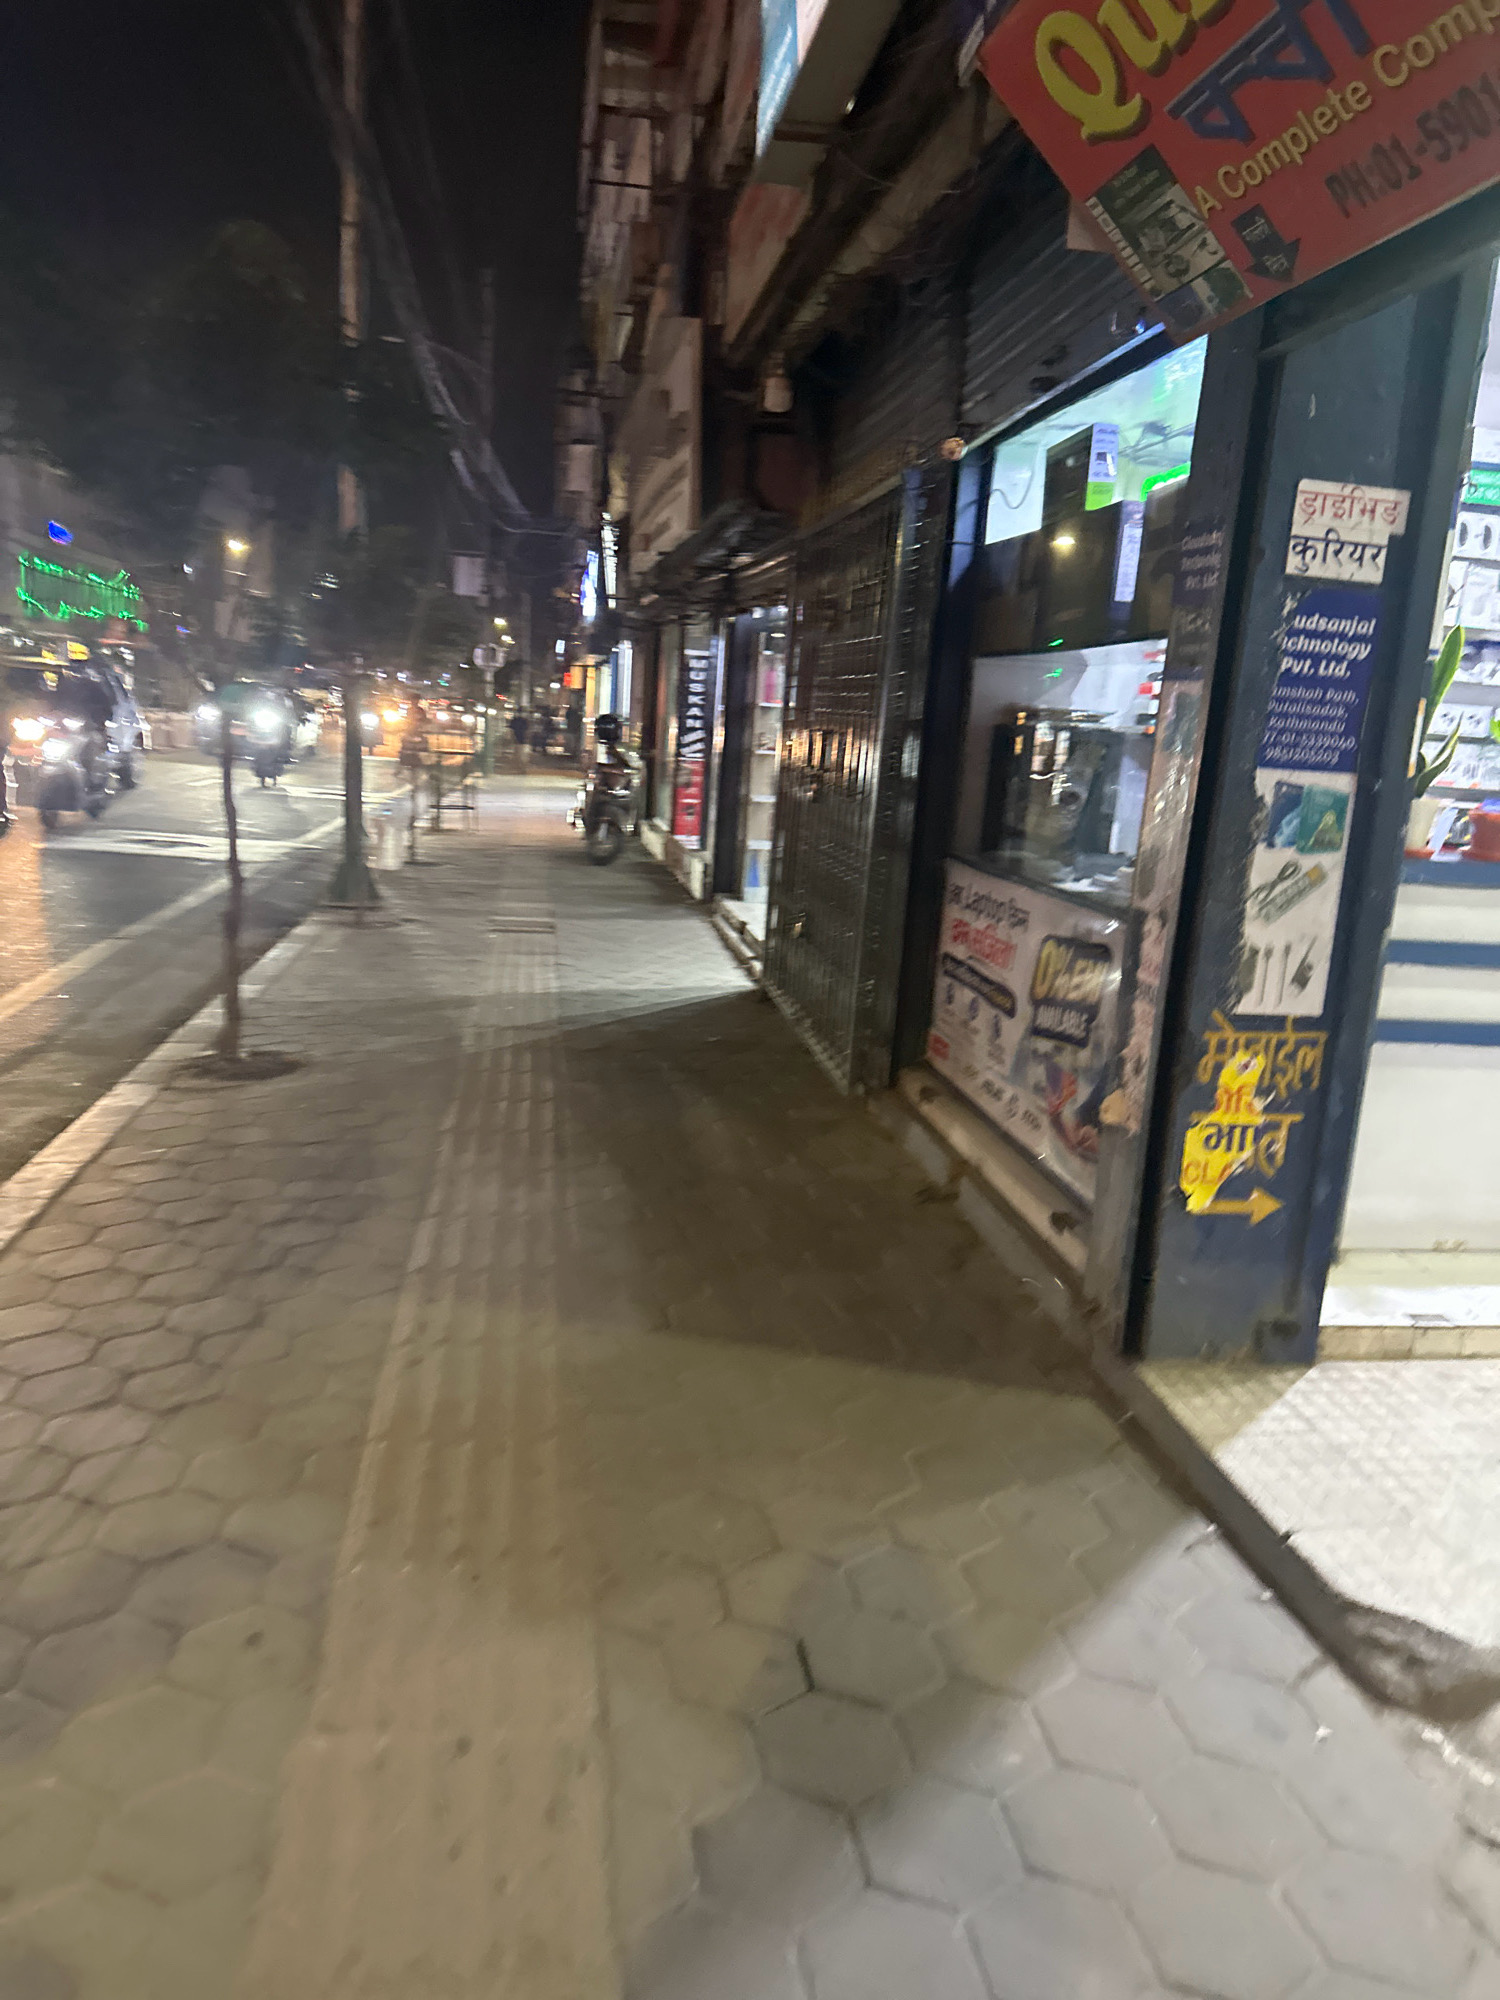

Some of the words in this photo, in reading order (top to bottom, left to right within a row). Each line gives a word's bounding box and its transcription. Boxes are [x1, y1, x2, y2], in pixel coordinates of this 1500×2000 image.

[1035, 0, 1226, 142] Qu
[1194, 186, 1222, 219] A
[1216, 80, 1373, 198] Complete
[1372, 0, 1500, 88] Comp
[1290, 528, 1388, 573] कुरियर
[1280, 635, 1372, 661] chnology
